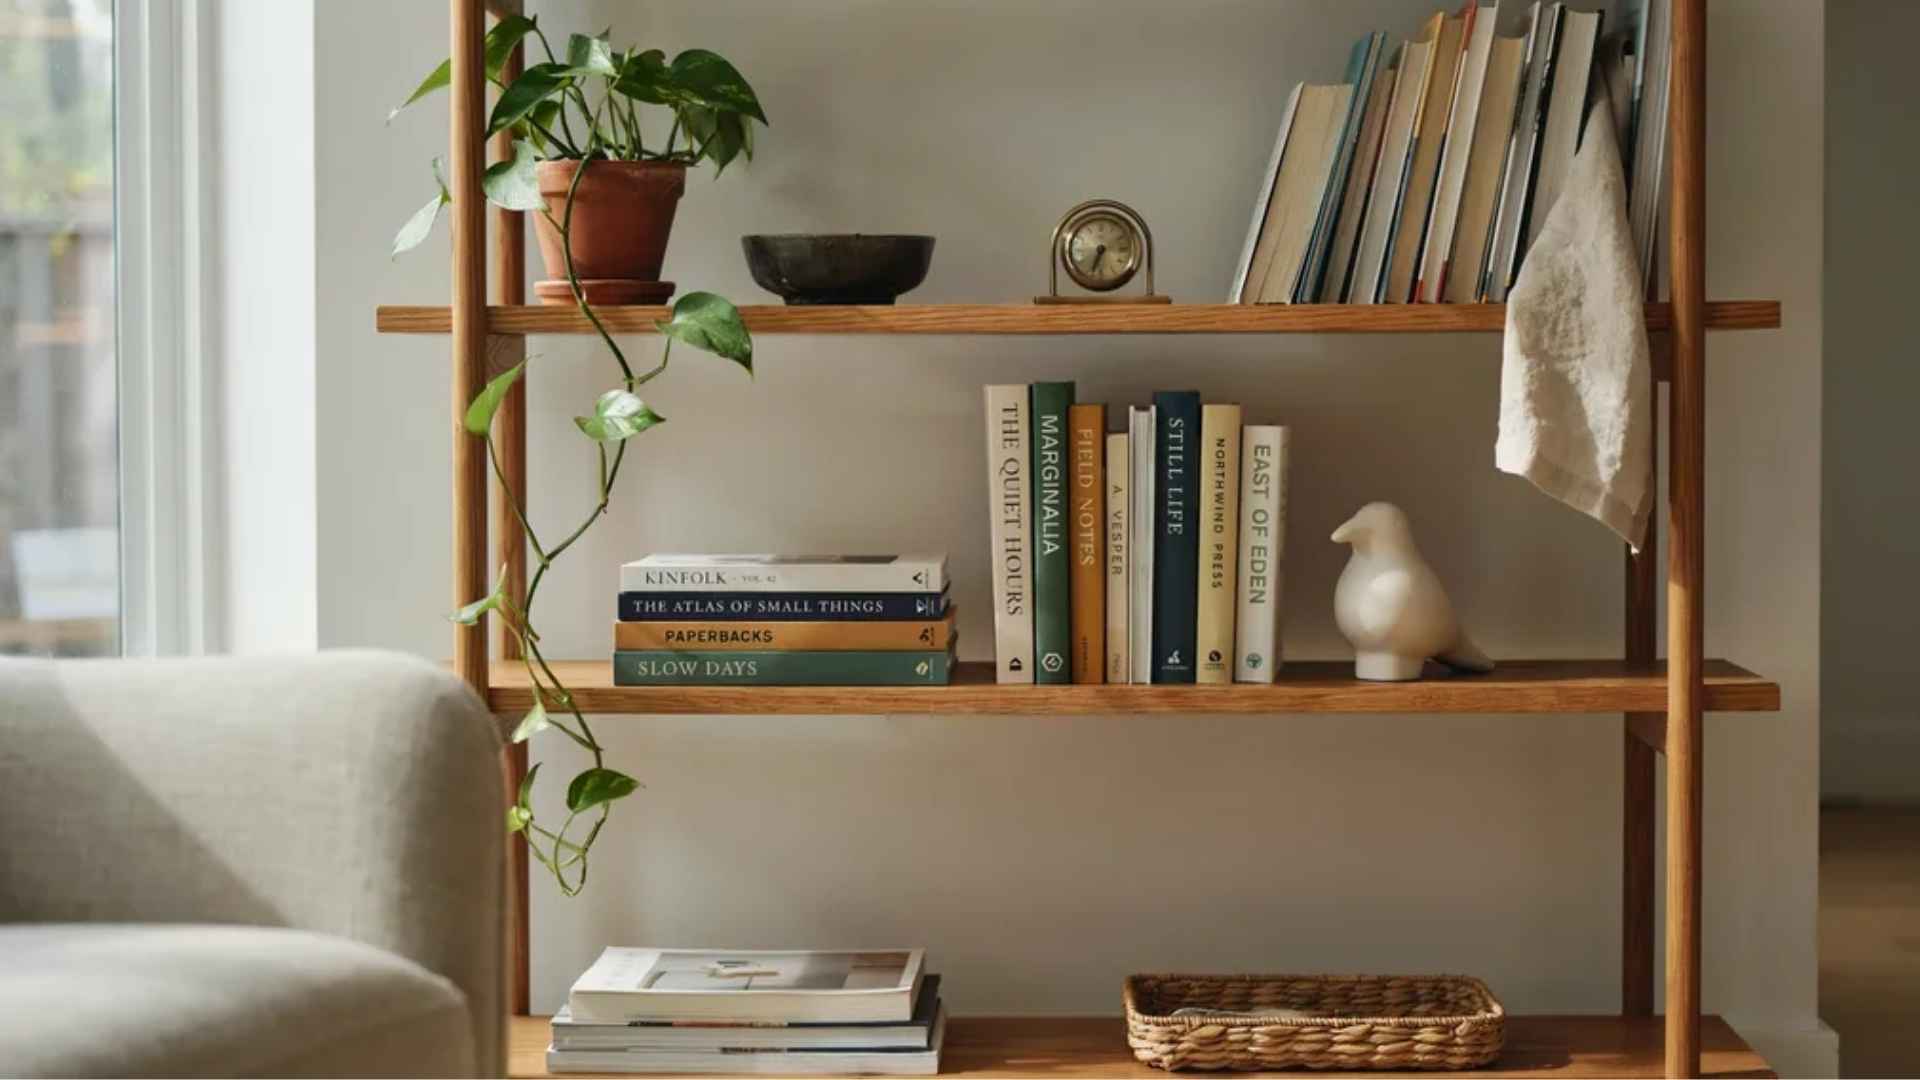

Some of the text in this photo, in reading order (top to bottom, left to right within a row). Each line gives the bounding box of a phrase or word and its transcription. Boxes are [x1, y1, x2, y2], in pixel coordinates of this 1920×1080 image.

[999, 403, 1023, 616] THE QUIET HOURS
[1041, 415, 1060, 556] MARGINALIA
[1078, 428, 1095, 566] FIELD NOTES
[1167, 417, 1184, 535] STILL LIFE
[1212, 438, 1225, 589] NORTHWIND PRESS
[1248, 444, 1271, 604] EAST OF EDEN
[646, 571, 727, 585] KINFOLK
[1111, 510, 1122, 576] VESPER
[633, 600, 884, 613] THE ATLAS OF SMALL THINGS
[665, 630, 773, 643] PAPERBACKS
[638, 661, 758, 676] SLOW DAYS
